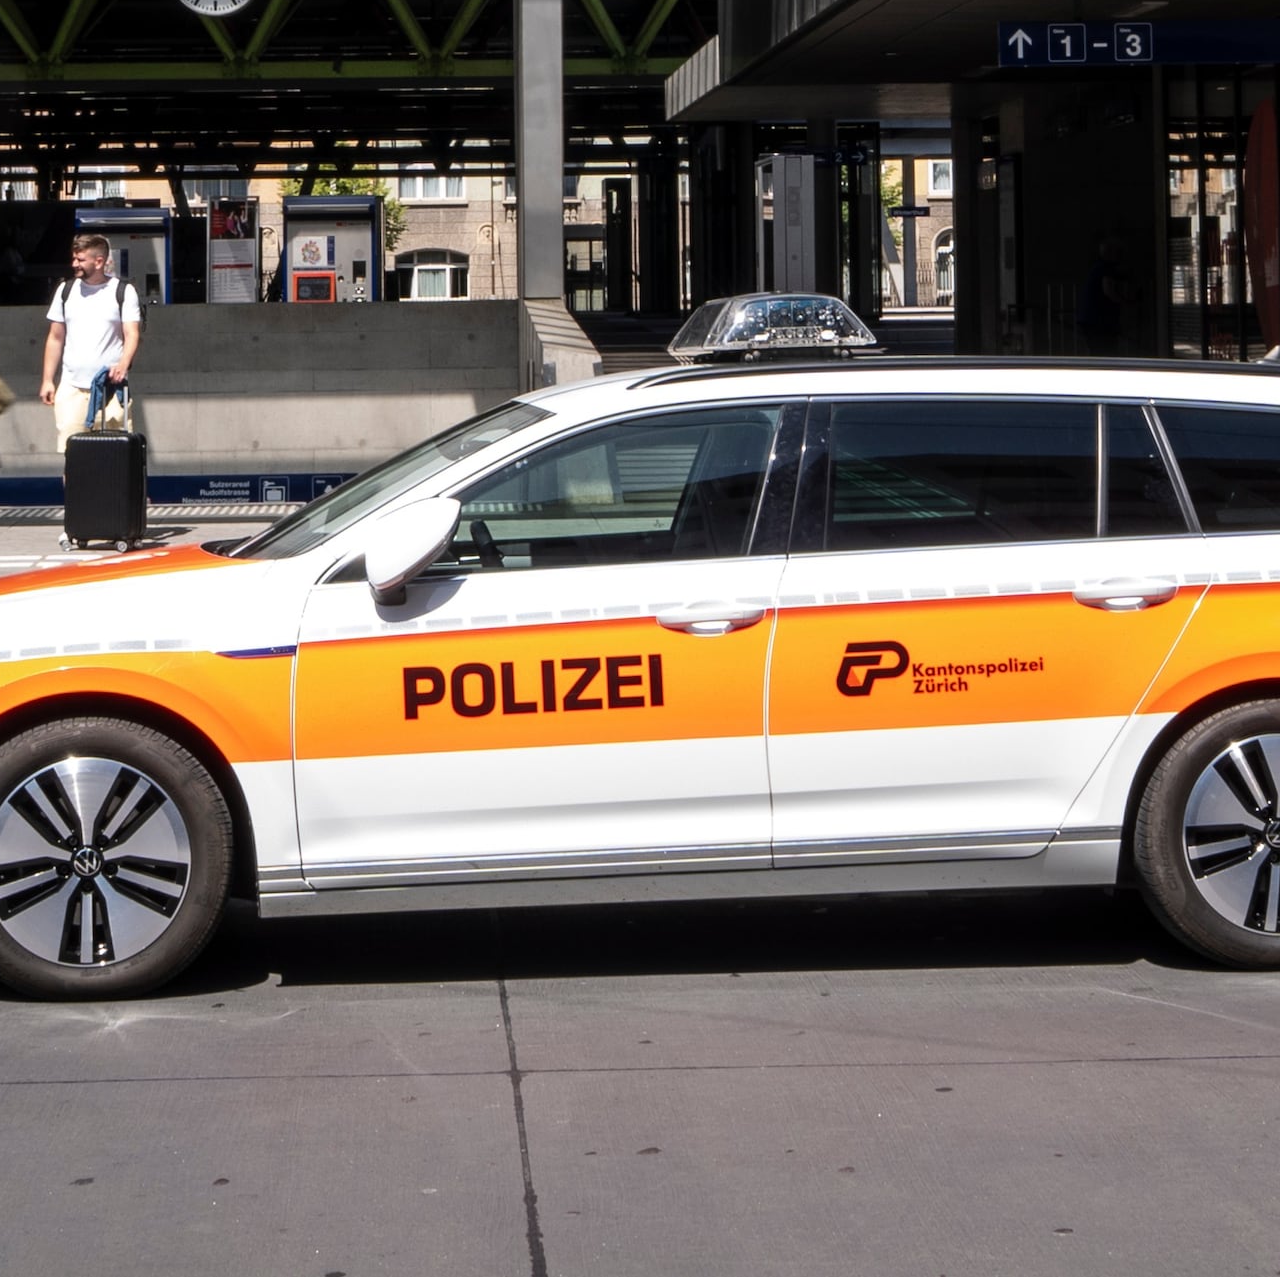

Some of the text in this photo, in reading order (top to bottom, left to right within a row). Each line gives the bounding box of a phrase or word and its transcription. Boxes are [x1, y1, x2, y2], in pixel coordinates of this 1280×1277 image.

[1060, 35, 1072, 57] 1
[1125, 34, 1142, 57] 3
[912, 657, 1045, 677] Kantonspolizei
[403, 654, 664, 720] POLIZEI
[913, 677, 969, 694] Zürich
